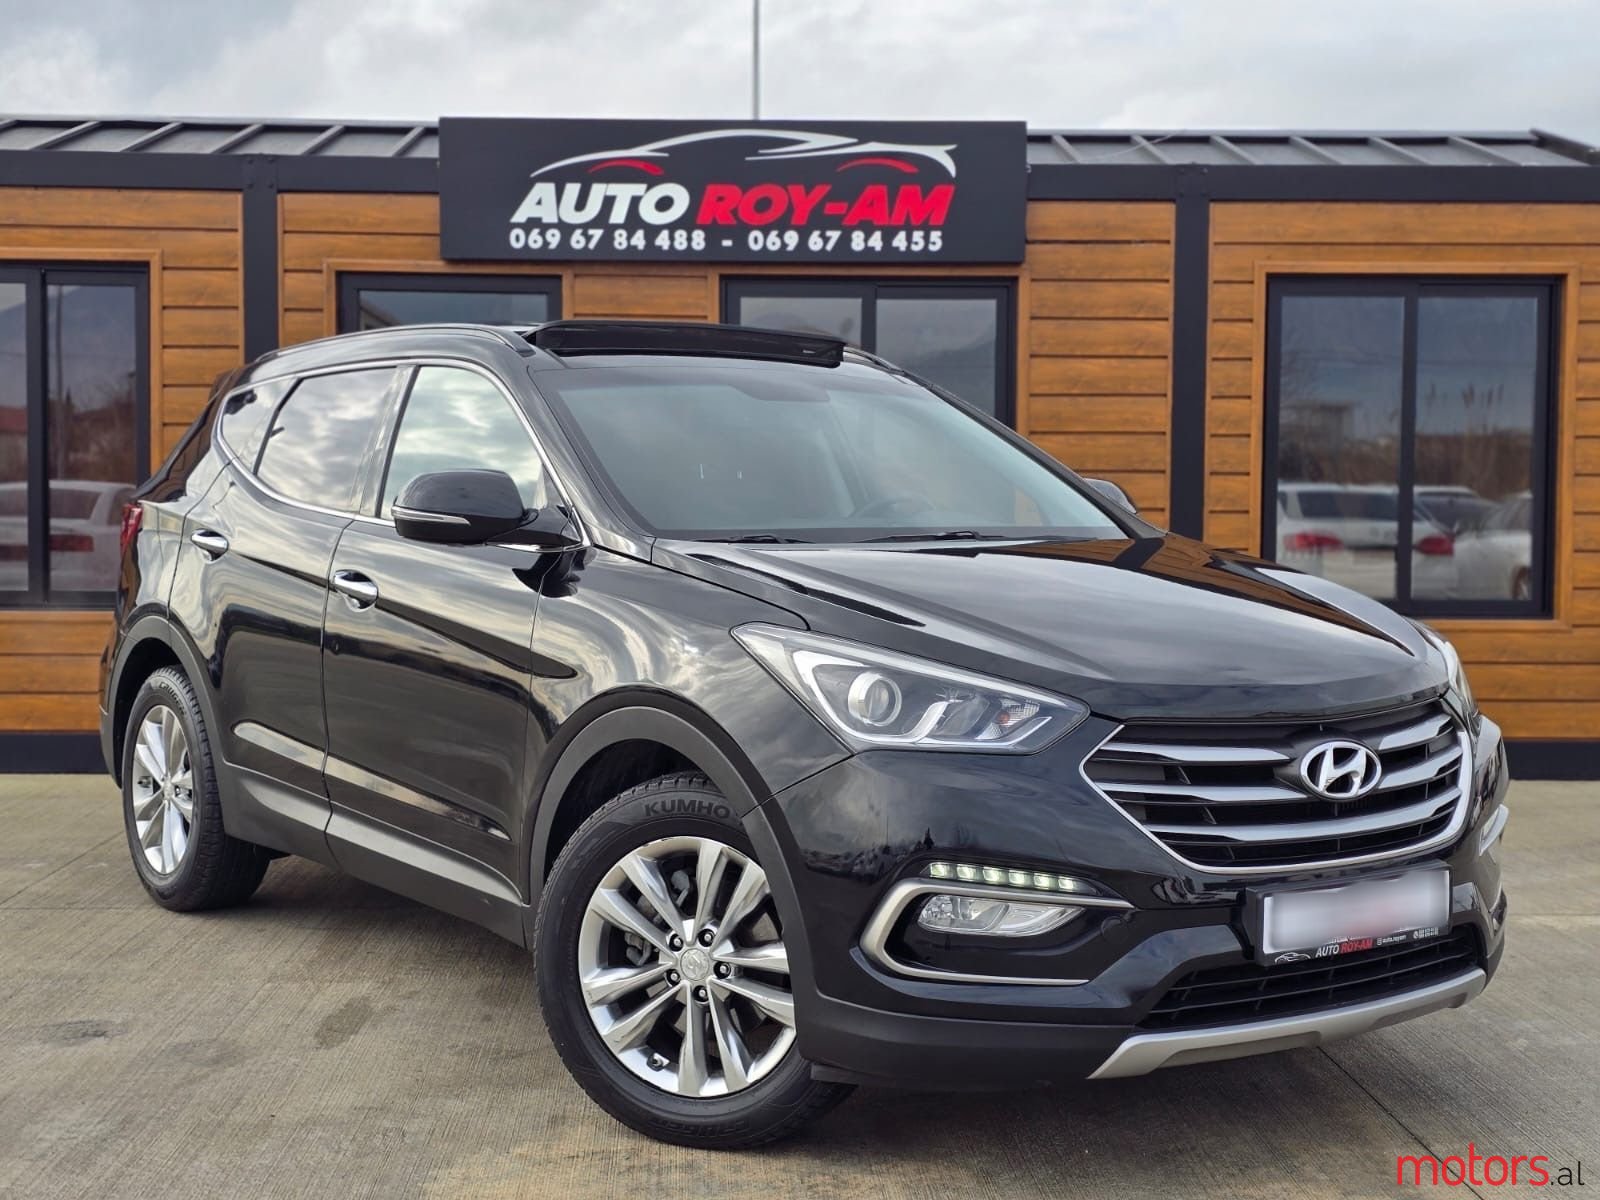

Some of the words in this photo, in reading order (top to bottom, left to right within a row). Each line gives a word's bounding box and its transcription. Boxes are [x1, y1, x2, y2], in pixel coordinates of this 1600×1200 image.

[510, 182, 690, 225] AUTO
[696, 183, 955, 227] ROY-AM
[508, 227, 562, 250] 069
[569, 228, 605, 250] 67
[613, 228, 647, 251] 84
[654, 228, 706, 251] 488
[721, 239, 733, 247] -
[747, 229, 800, 252] 069
[807, 230, 842, 252] 67
[850, 230, 884, 252] 84
[891, 230, 943, 253] 455
[645, 800, 730, 818] KUMHO
[1314, 944, 1340, 958] AUTO
